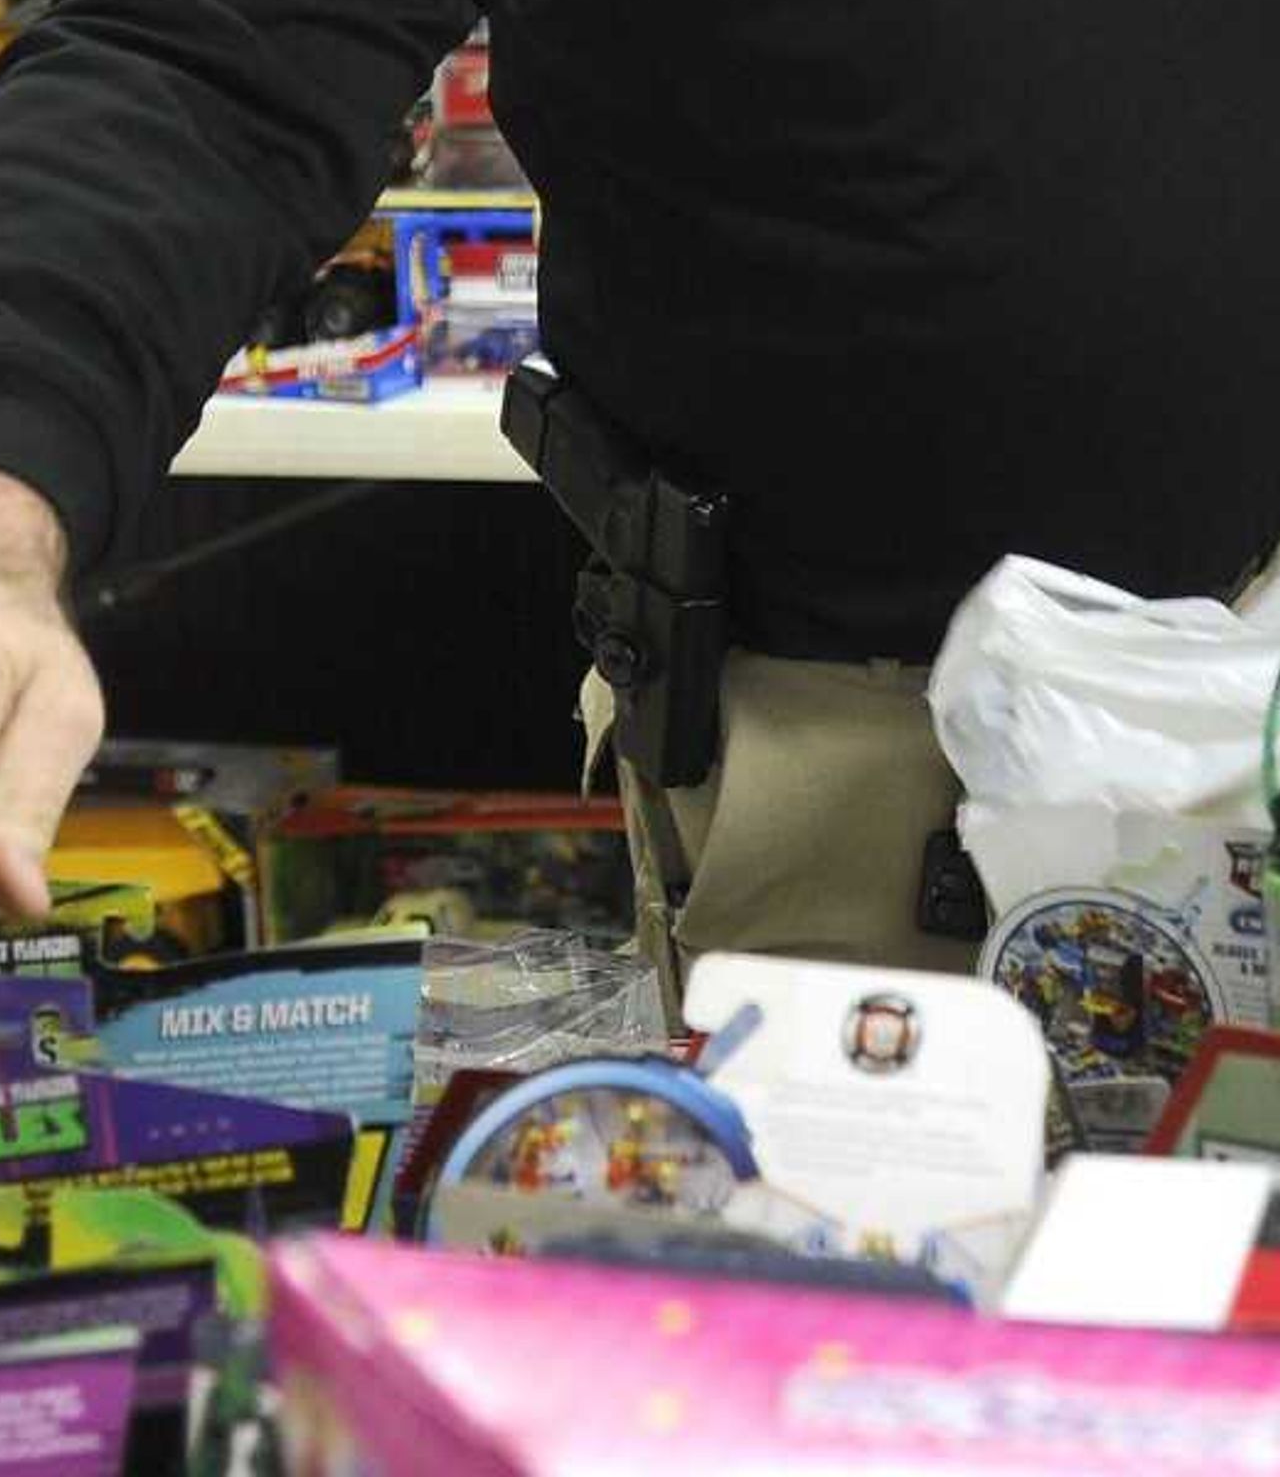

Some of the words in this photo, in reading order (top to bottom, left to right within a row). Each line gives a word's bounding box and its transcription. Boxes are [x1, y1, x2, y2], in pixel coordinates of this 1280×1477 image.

[160, 1004, 223, 1038] MIX
[232, 1003, 257, 1033] &
[259, 993, 371, 1032] MATCH
